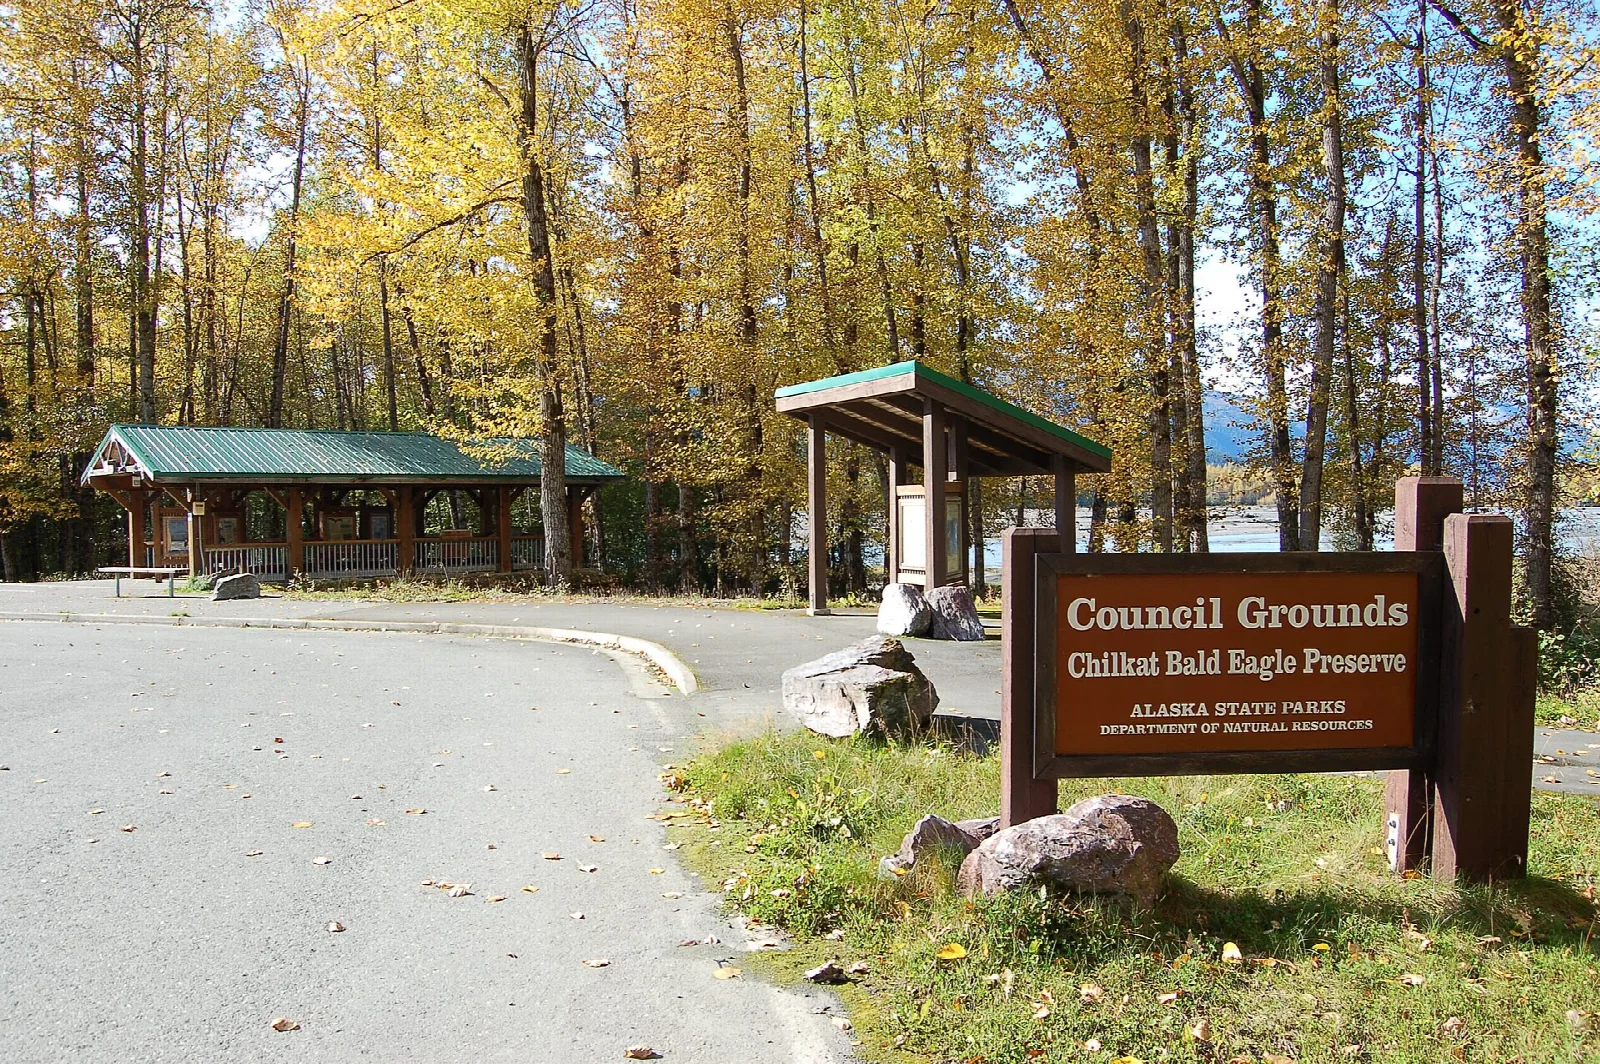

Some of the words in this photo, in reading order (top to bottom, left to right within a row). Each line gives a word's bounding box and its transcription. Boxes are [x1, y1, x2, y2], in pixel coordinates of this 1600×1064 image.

[1067, 597, 1223, 630] Council
[1238, 595, 1408, 628] Grounds
[1068, 652, 1159, 678] Chilkat
[1165, 649, 1221, 675] Bald
[1228, 649, 1296, 681] Eagle
[1303, 649, 1406, 673] Preserve
[1130, 703, 1209, 717] ALASKA
[1215, 702, 1276, 716] STATE
[1282, 701, 1345, 714] PARKS
[1100, 724, 1197, 734] DEPARTMENT
[1201, 723, 1219, 733] OF
[1223, 722, 1288, 733] NATURAL
[1292, 720, 1372, 731] RESOURCES
